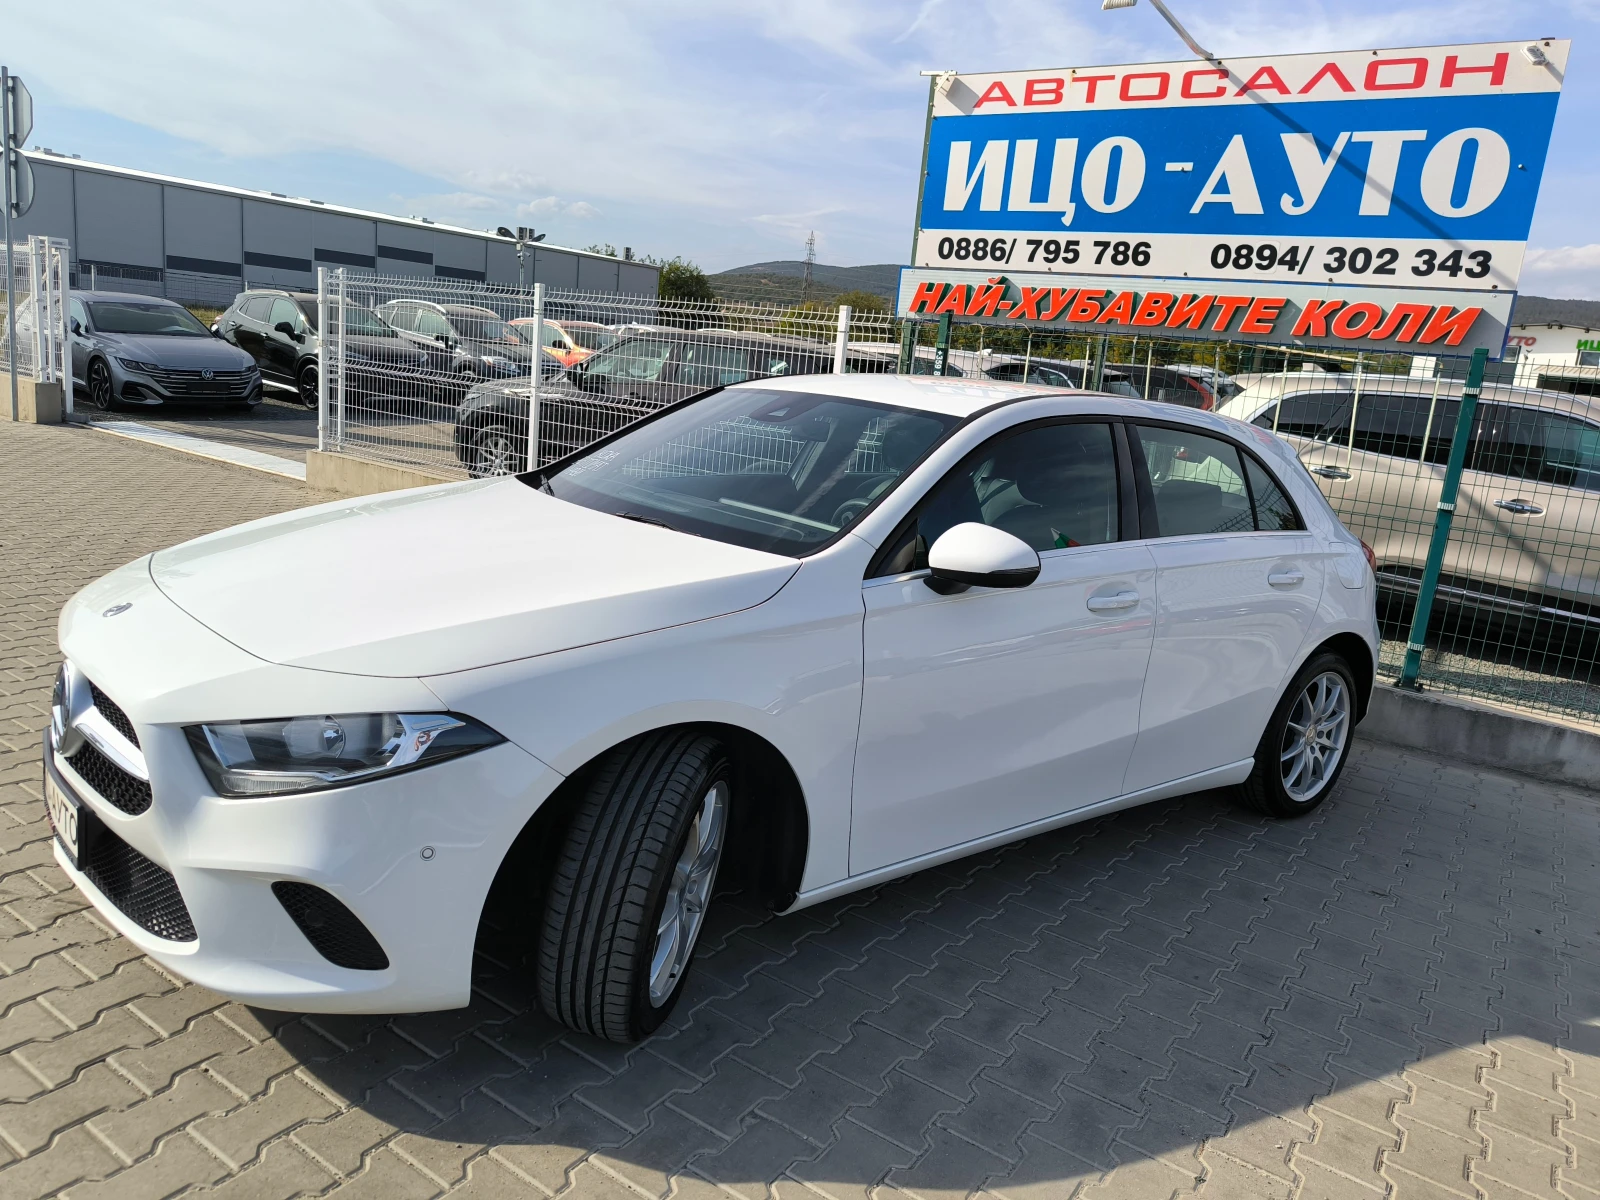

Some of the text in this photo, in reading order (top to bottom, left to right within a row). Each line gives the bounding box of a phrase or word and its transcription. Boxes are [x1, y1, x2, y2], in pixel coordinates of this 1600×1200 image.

[973, 52, 1509, 108] АВТОСАЛОН
[937, 237, 1493, 279] 0886/ 795 786 0894/ 302 343
[908, 276, 1483, 346] НАЙ-ХУБАВИТЕ КОЛИ
